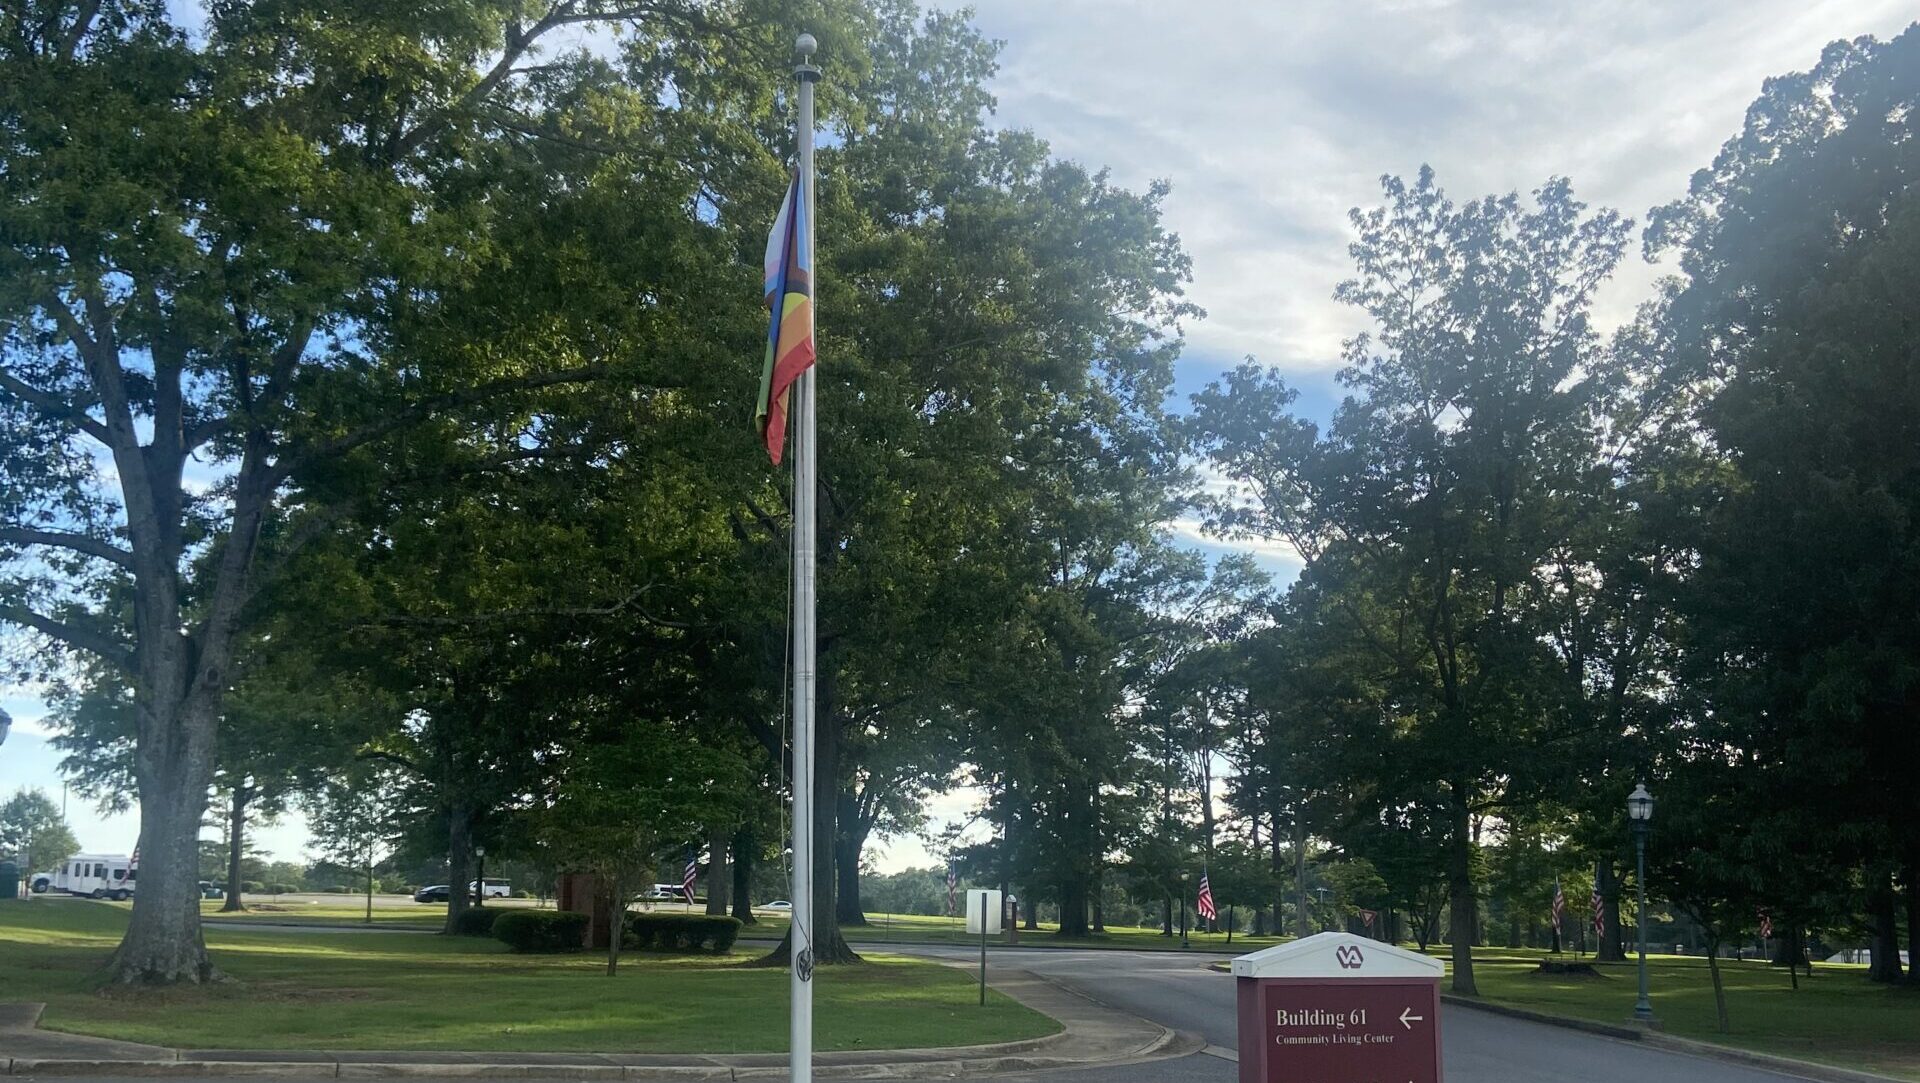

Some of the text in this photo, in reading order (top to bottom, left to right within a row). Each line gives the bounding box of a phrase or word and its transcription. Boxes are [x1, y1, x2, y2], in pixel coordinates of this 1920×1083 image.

[1336, 946, 1364, 968] VA
[1276, 1009, 1367, 1028] Building 61
[1276, 1033, 1394, 1046] Community Living Center
